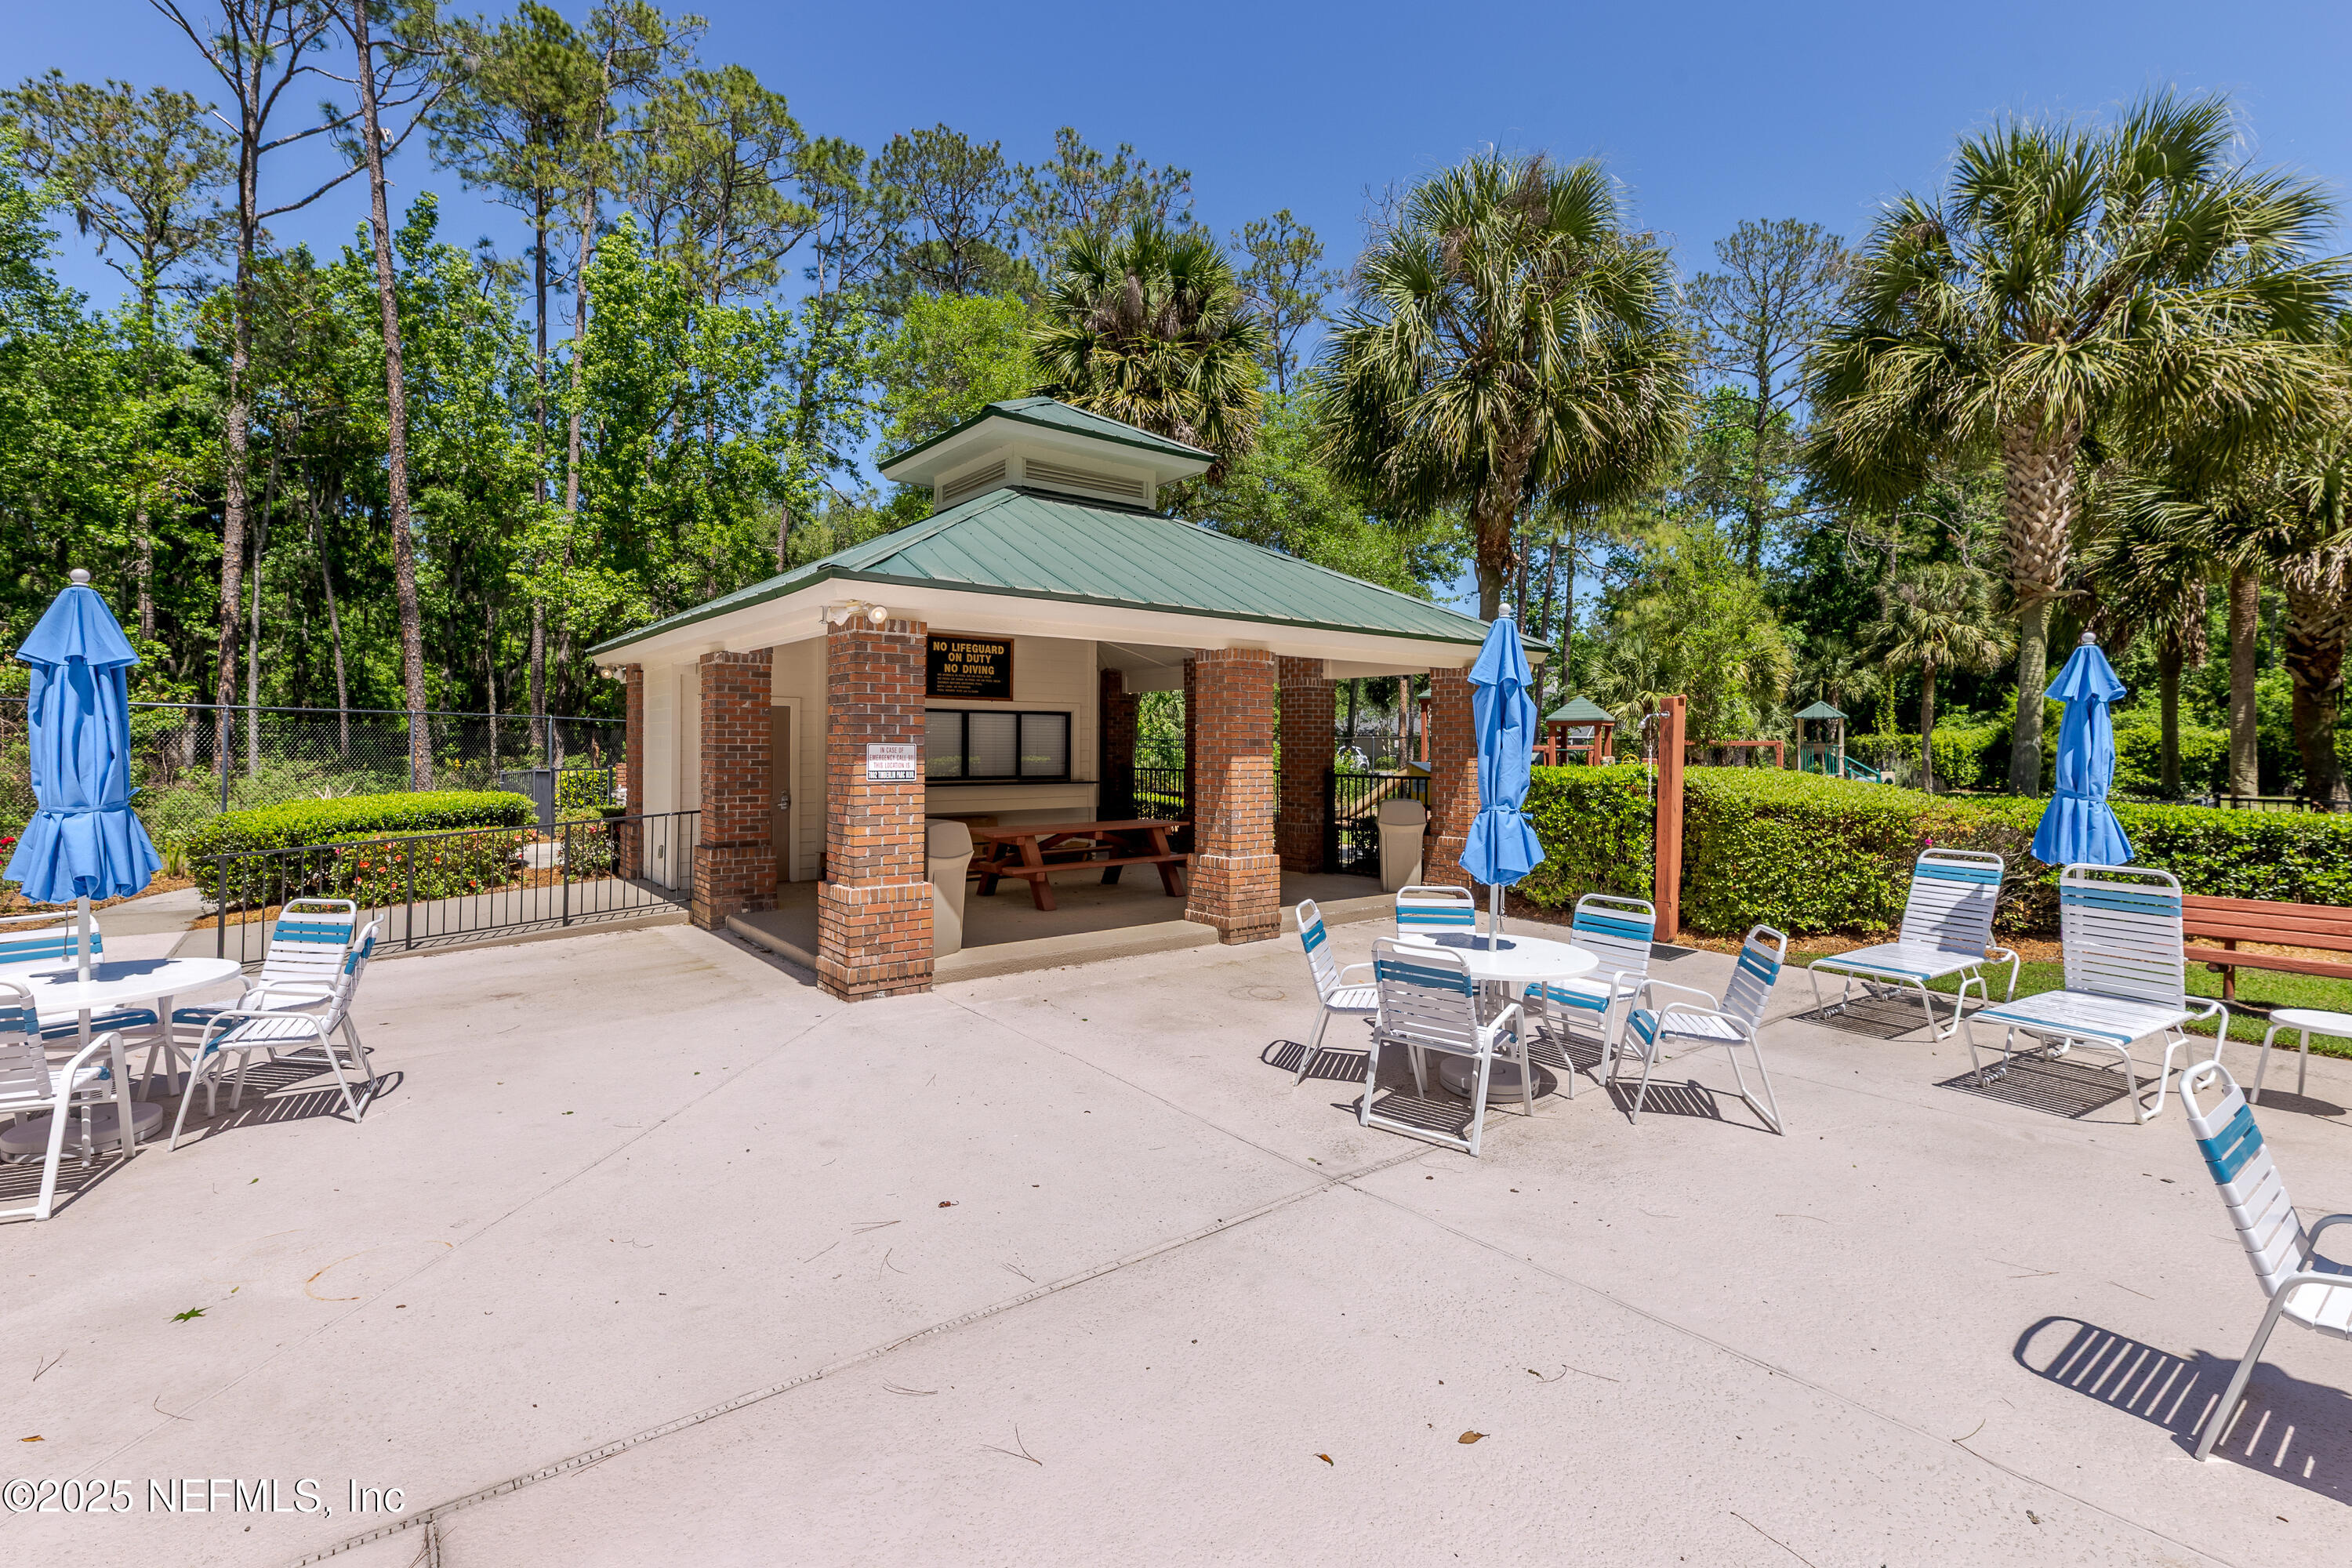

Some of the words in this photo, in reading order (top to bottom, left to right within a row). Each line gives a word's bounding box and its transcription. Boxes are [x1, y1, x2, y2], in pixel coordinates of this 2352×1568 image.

[933, 641, 947, 652] NO
[952, 643, 1004, 654] LIFEGUARD
[948, 652, 962, 662] ON
[966, 653, 992, 663] DUTY
[944, 663, 958, 673] NO
[962, 664, 995, 675] DIVING
